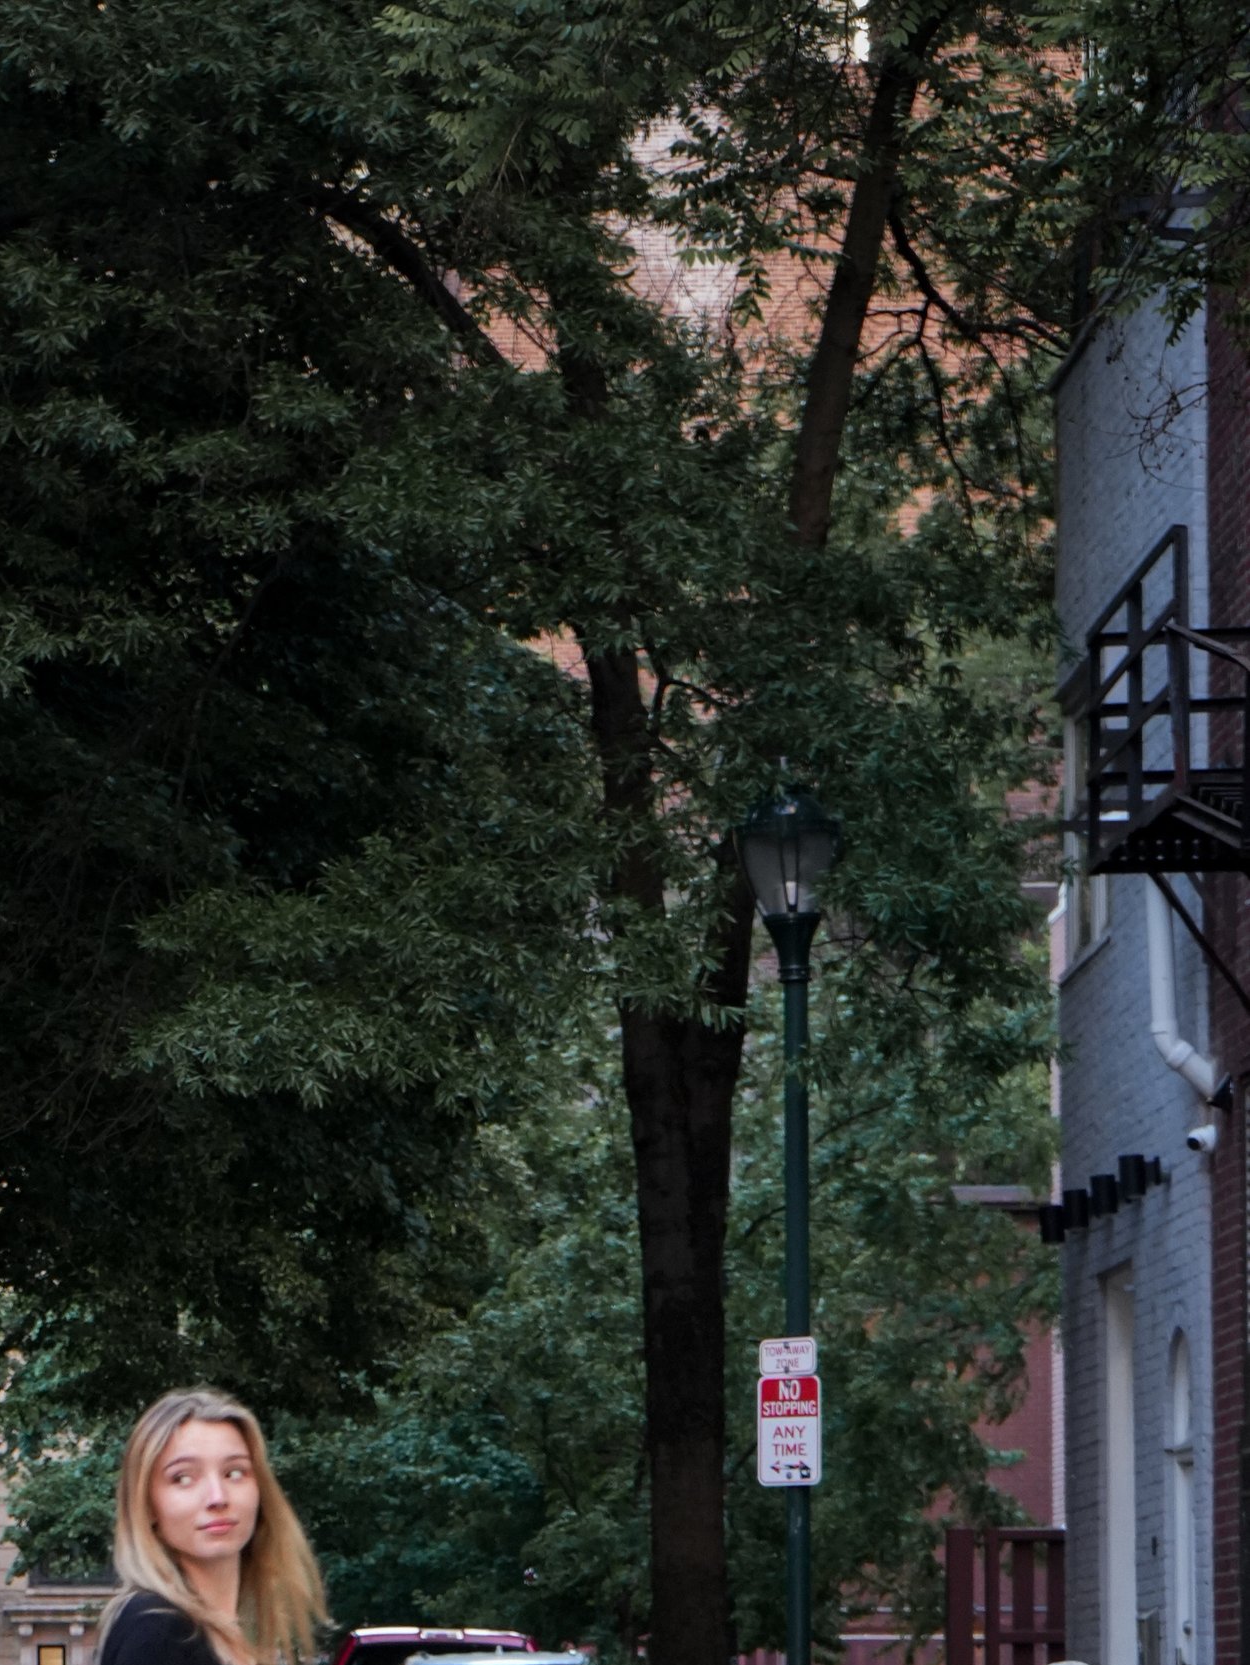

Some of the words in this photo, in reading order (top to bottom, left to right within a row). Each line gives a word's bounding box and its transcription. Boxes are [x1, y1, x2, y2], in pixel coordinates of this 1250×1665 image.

[764, 1344, 811, 1357] TOW-AWAY
[775, 1357, 799, 1369] ZONE
[778, 1380, 801, 1400] NO
[762, 1401, 817, 1415] STOPPING
[773, 1426, 805, 1438] ANY
[773, 1444, 807, 1456] TIME
